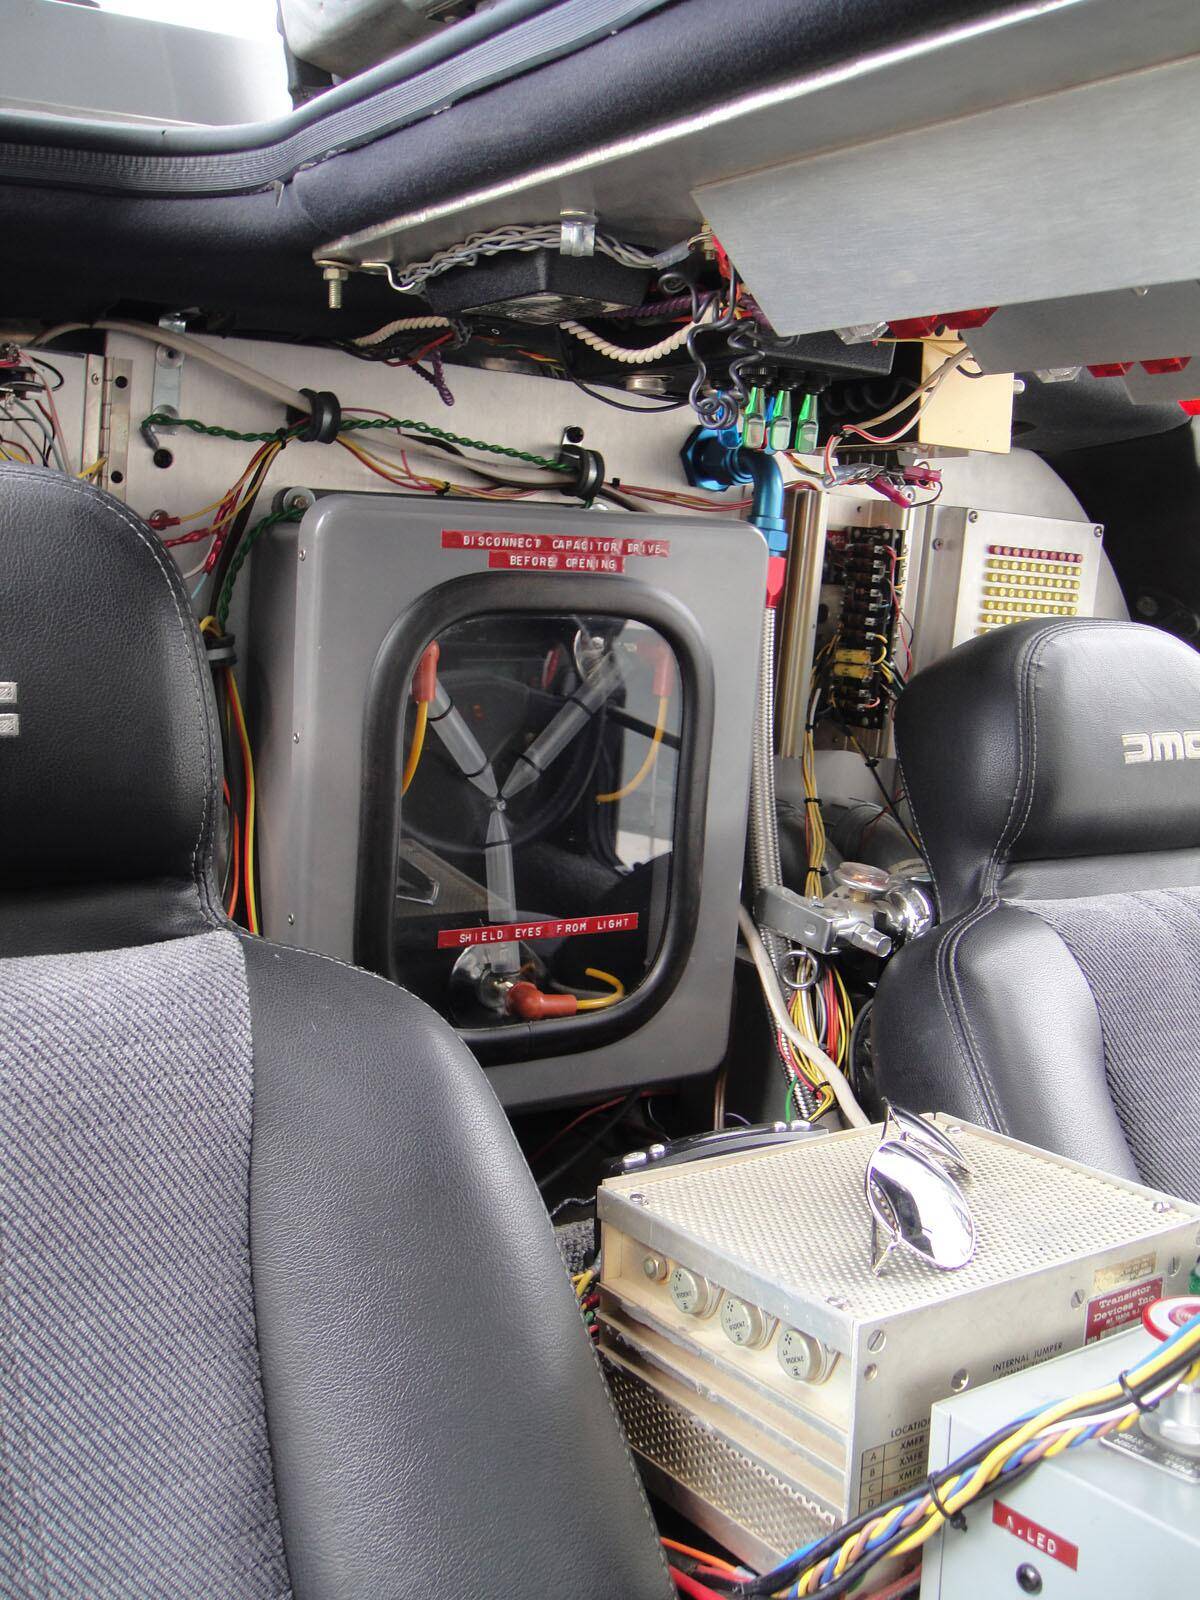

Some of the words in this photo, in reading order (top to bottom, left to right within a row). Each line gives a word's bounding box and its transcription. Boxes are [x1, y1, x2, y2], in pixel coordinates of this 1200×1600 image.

[463, 535, 542, 549] DISCONNECT
[552, 538, 618, 553] CAPACITOR
[627, 542, 661, 555] DRIVE
[510, 555, 554, 567] BEFORE
[565, 557, 616, 570] OPENING
[459, 930, 503, 943] SHIELD
[515, 926, 542, 938] EYES
[556, 922, 587, 934] FROM
[597, 918, 629, 931] LIGHT
[1098, 1285, 1151, 1308] Transistor
[1093, 1302, 1134, 1322] Devices
[992, 1353, 1029, 1373] INTERNAL
[1034, 1342, 1063, 1358] JUMPER
